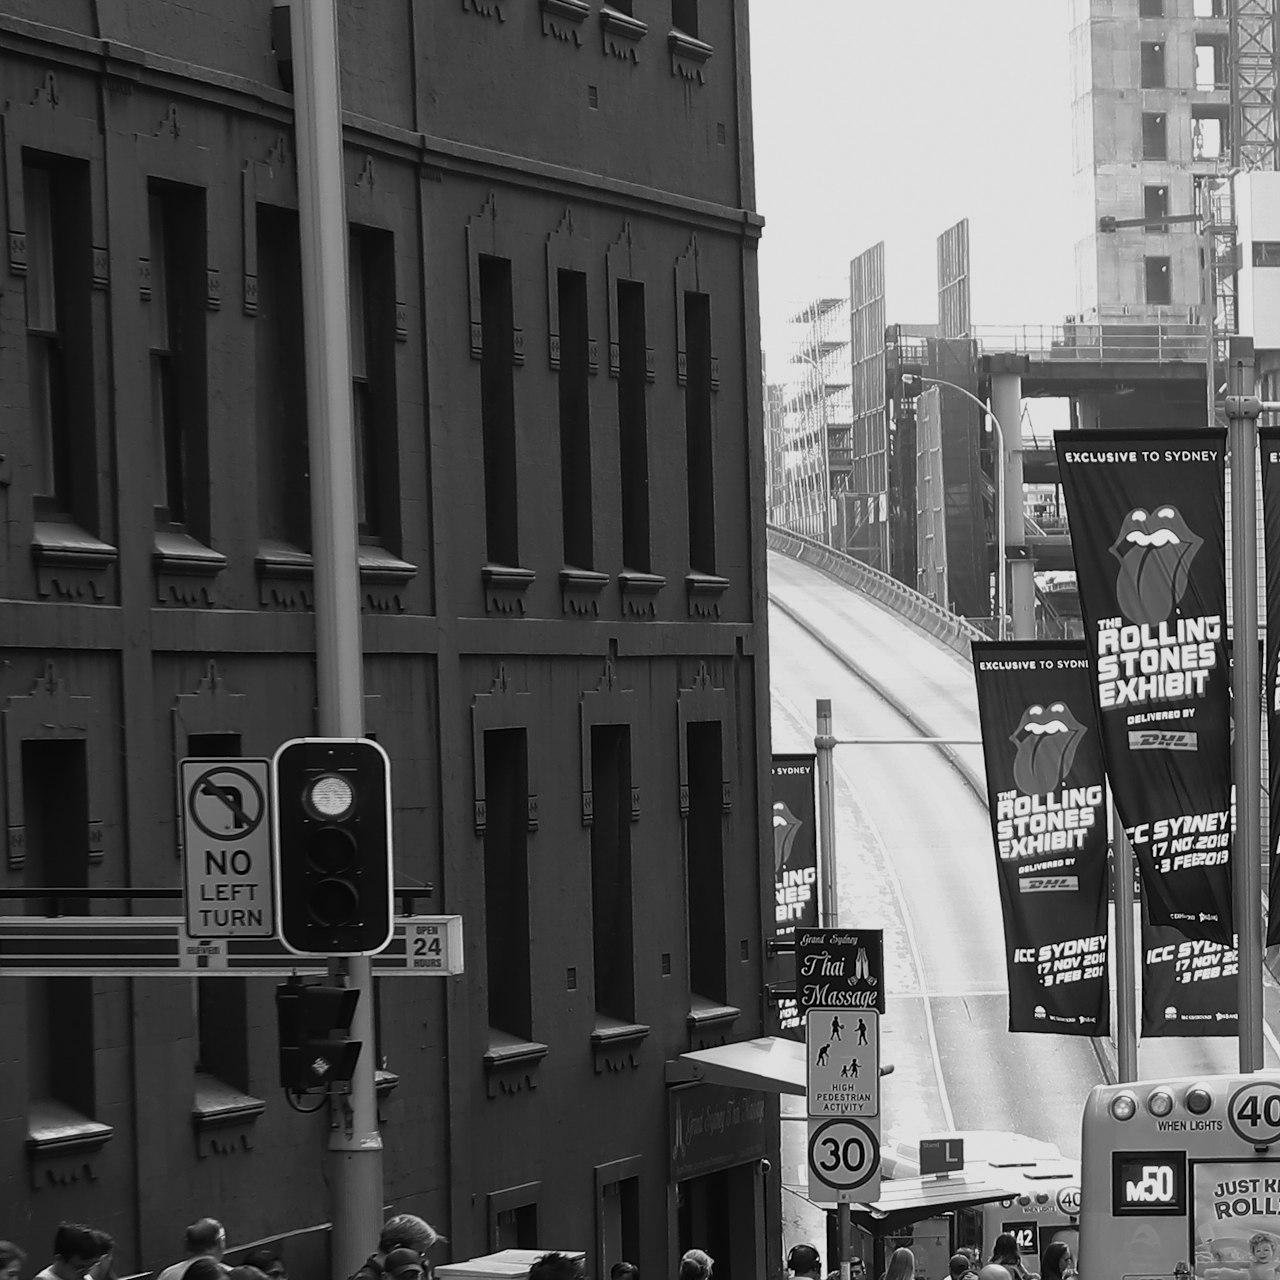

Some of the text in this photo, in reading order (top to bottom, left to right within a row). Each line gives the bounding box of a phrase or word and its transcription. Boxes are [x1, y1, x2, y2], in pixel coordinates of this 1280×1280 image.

[1065, 451, 1217, 463] EXCLUSIVE TO SYDNEY
[1097, 617, 1122, 630] THE
[1098, 614, 1220, 656] ROLLING
[980, 660, 1089, 670] EXCLUSIVE TO SYDN
[1097, 643, 1216, 683] STONES
[1099, 670, 1209, 708] EXHIBIT
[1127, 708, 1195, 724] DELIVERED BY
[1139, 733, 1188, 747] DHL
[777, 767, 810, 775] SYDNEY
[997, 790, 1017, 801] THE
[997, 786, 1101, 819] ROLLING
[997, 807, 1095, 839] STONES
[998, 828, 1087, 858] EXHIBIT
[1152, 833, 1229, 857] 17 2018
[205, 850, 251, 875] NO
[1019, 858, 1076, 874] DELIVERED BY
[200, 883, 257, 901] LEFT
[1028, 878, 1070, 890] DHL
[200, 910, 262, 926] TURN
[416, 926, 438, 935] OPEN
[413, 938, 441, 956] 24
[800, 935, 858, 946] Grand Sydney
[1014, 935, 1107, 963] ICC SYDNEY
[413, 958, 442, 968] HOURS
[801, 951, 845, 976] Thai
[1147, 945, 1175, 964] ICC
[1175, 953, 1221, 972] 17 NOV
[1037, 956, 1081, 974] 17 NOV
[1194, 966, 1221, 981] FEB
[1055, 966, 1103, 984] FEB 201
[801, 984, 877, 1008] Massage
[817, 1093, 870, 1101] PEDESTRIAN
[832, 1084, 854, 1092] HIGH
[823, 1103, 864, 1111] ACTIVITY
[1158, 1121, 1187, 1131] WHEN
[1190, 1120, 1223, 1131] LIGHTS
[820, 1137, 865, 1172] 30
[946, 1142, 958, 1162] L
[1126, 1166, 1173, 1202] M50
[1214, 1179, 1260, 1198] JUST
